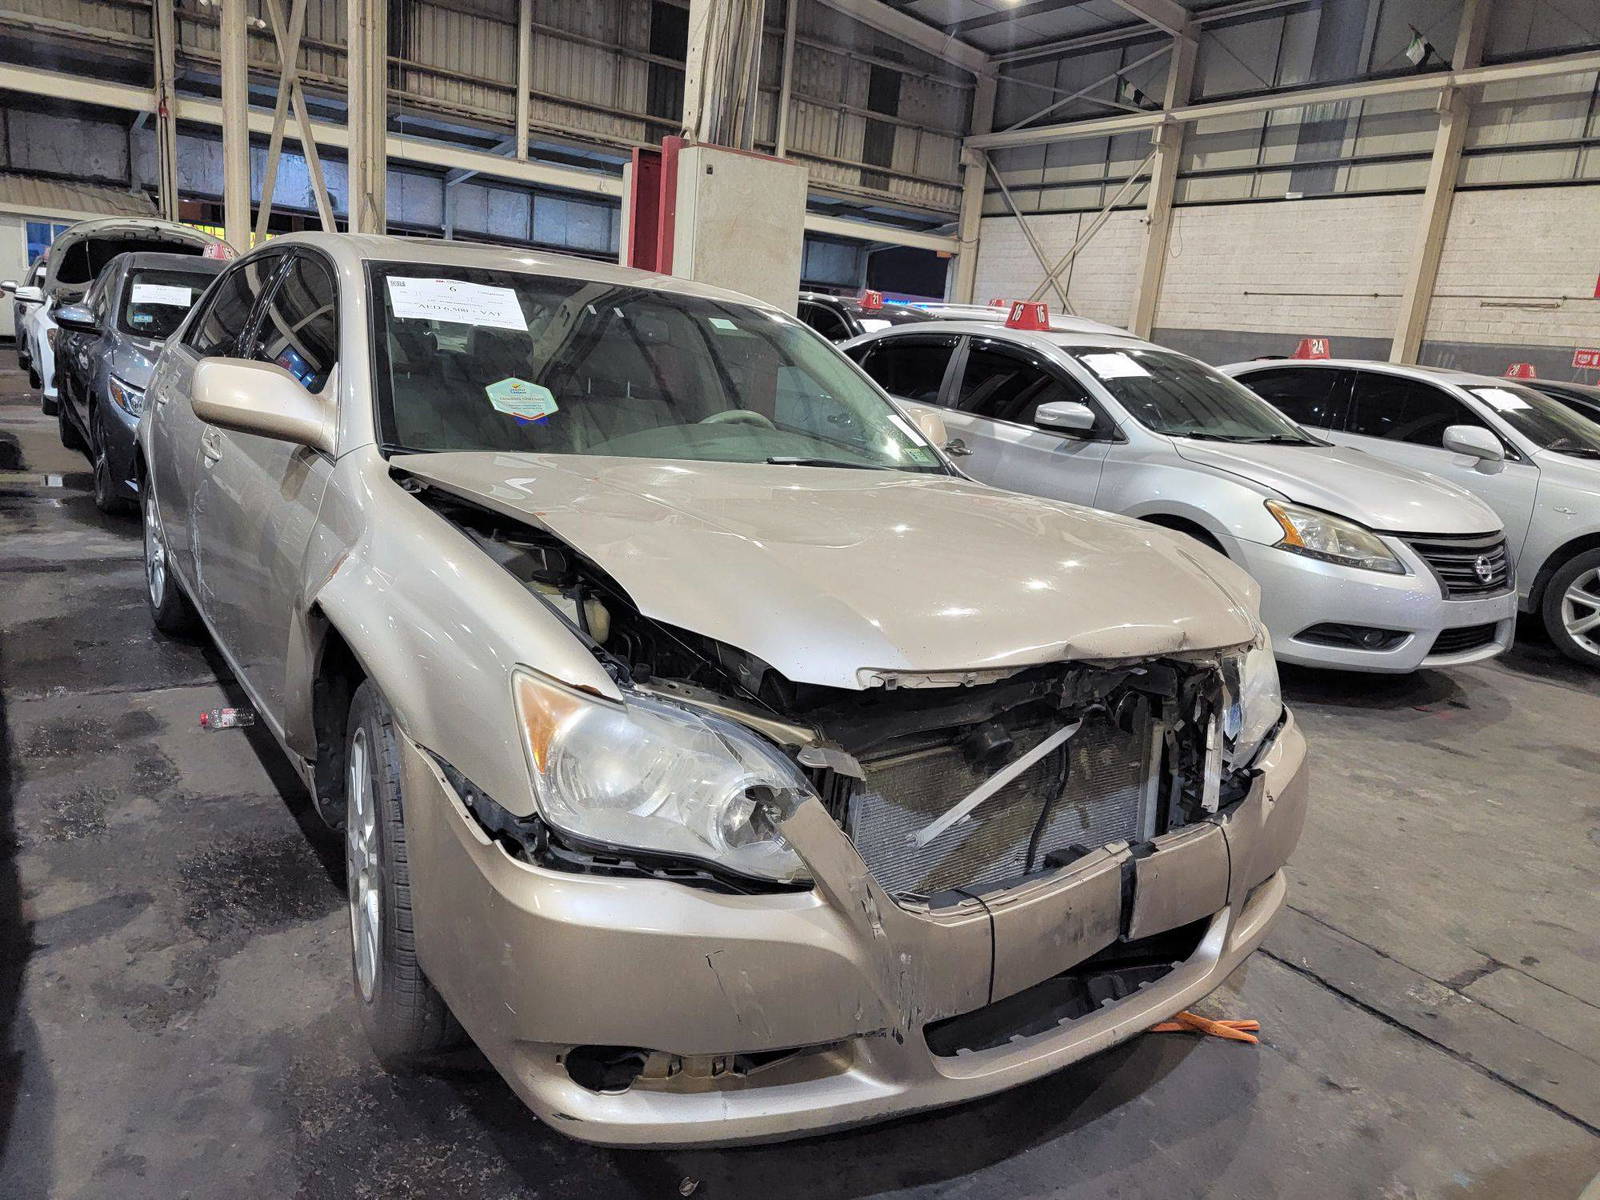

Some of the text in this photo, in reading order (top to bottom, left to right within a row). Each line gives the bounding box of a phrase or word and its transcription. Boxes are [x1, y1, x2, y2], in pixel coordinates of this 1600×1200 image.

[873, 295, 879, 305] 21
[1011, 303, 1024, 321] 16
[1036, 305, 1046, 323] 16
[1312, 339, 1324, 354] 24
